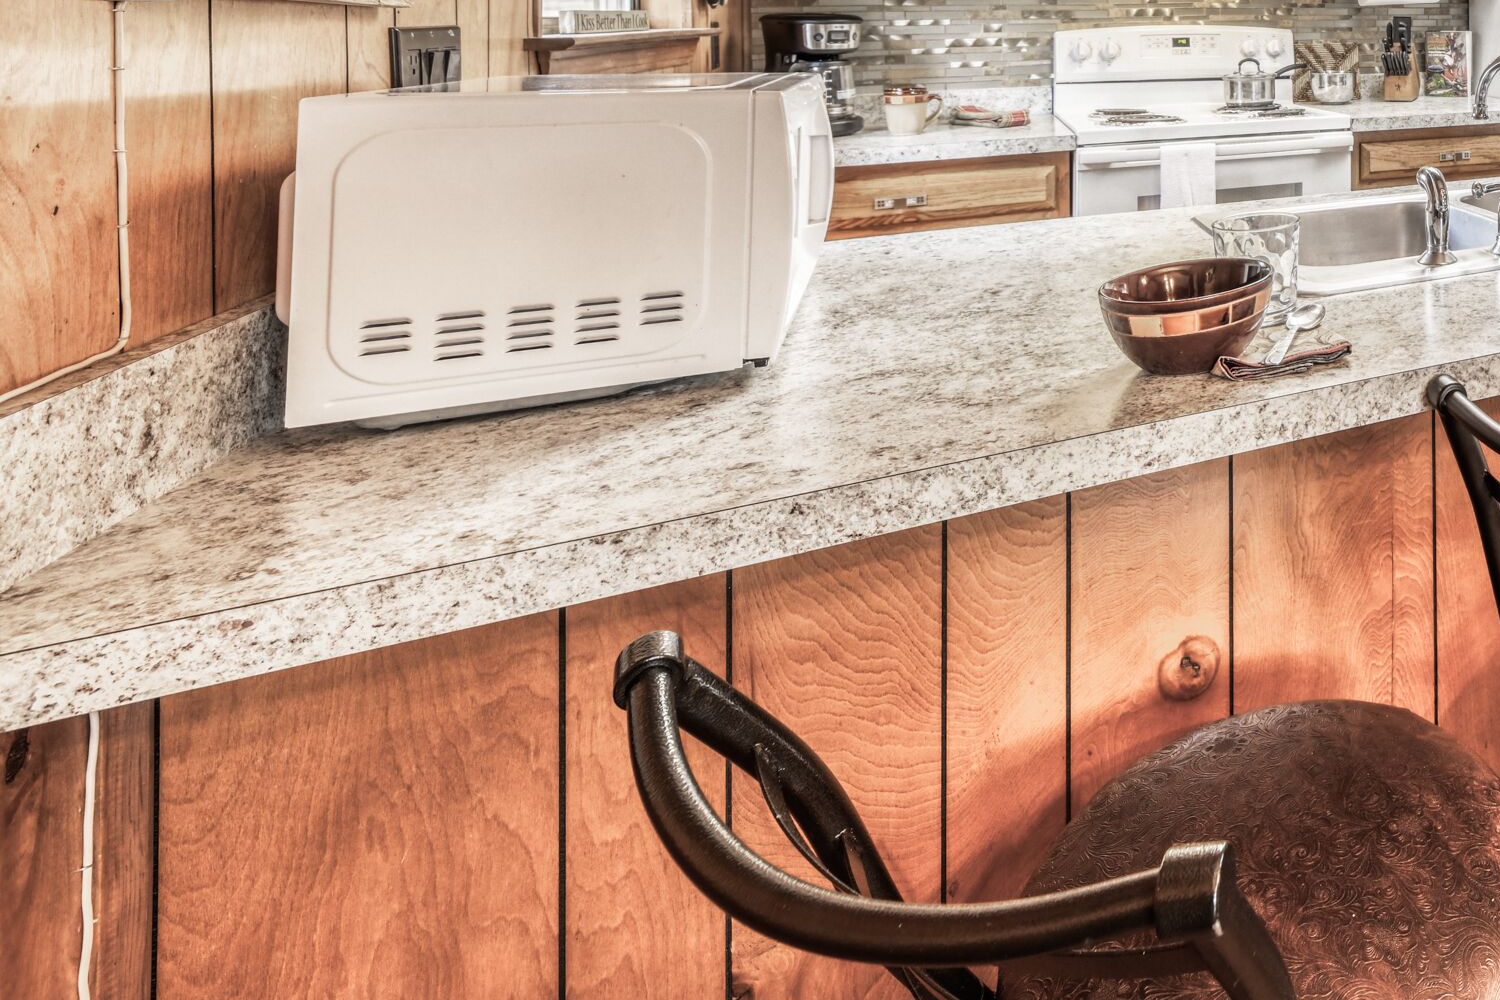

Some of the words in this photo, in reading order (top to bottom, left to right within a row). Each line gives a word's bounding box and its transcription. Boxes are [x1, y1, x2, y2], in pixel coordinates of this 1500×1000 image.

[581, 13, 595, 31] Kiss
[596, 14, 615, 30] Better
[617, 13, 631, 29] Than
[636, 13, 648, 28] Cook
